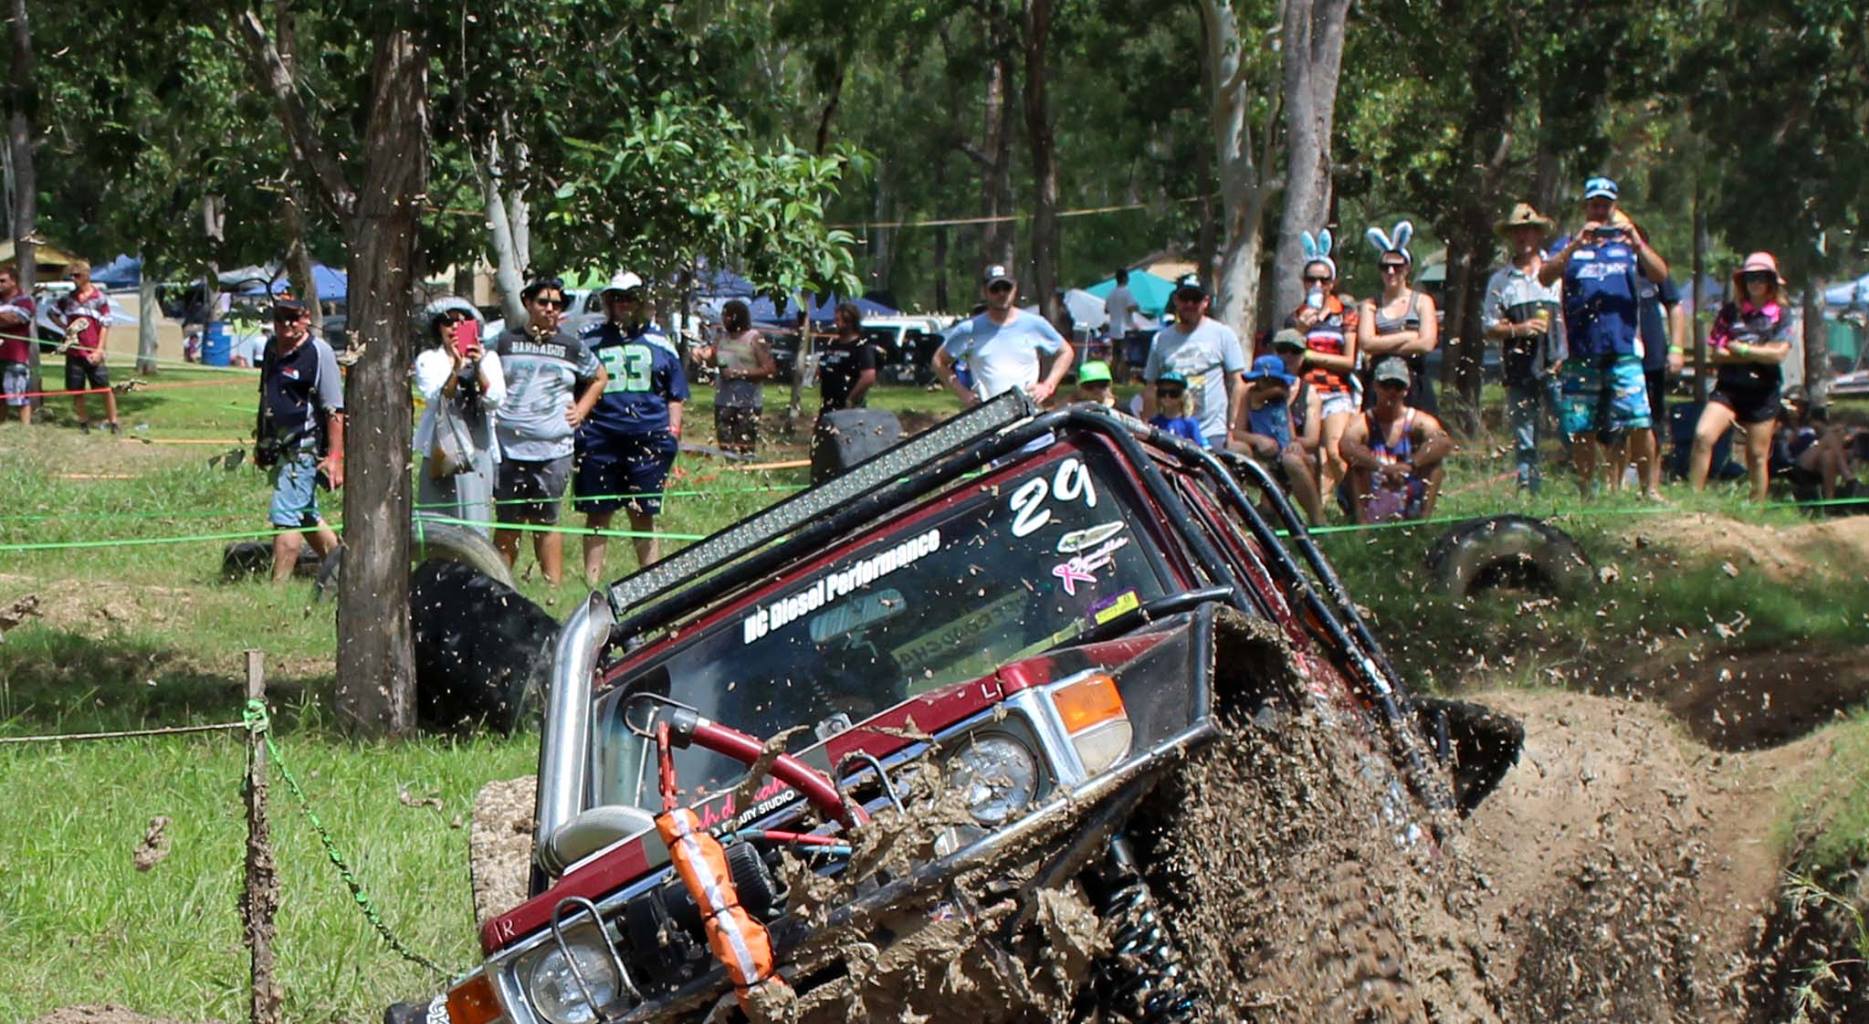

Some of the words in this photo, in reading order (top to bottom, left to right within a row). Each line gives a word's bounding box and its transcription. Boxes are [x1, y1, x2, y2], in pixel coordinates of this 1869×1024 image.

[600, 345, 652, 394] 33
[1010, 458, 1097, 537] 29
[770, 579, 825, 630] Diesel
[826, 529, 941, 602] Performance
[759, 790, 795, 815] STUDIO
